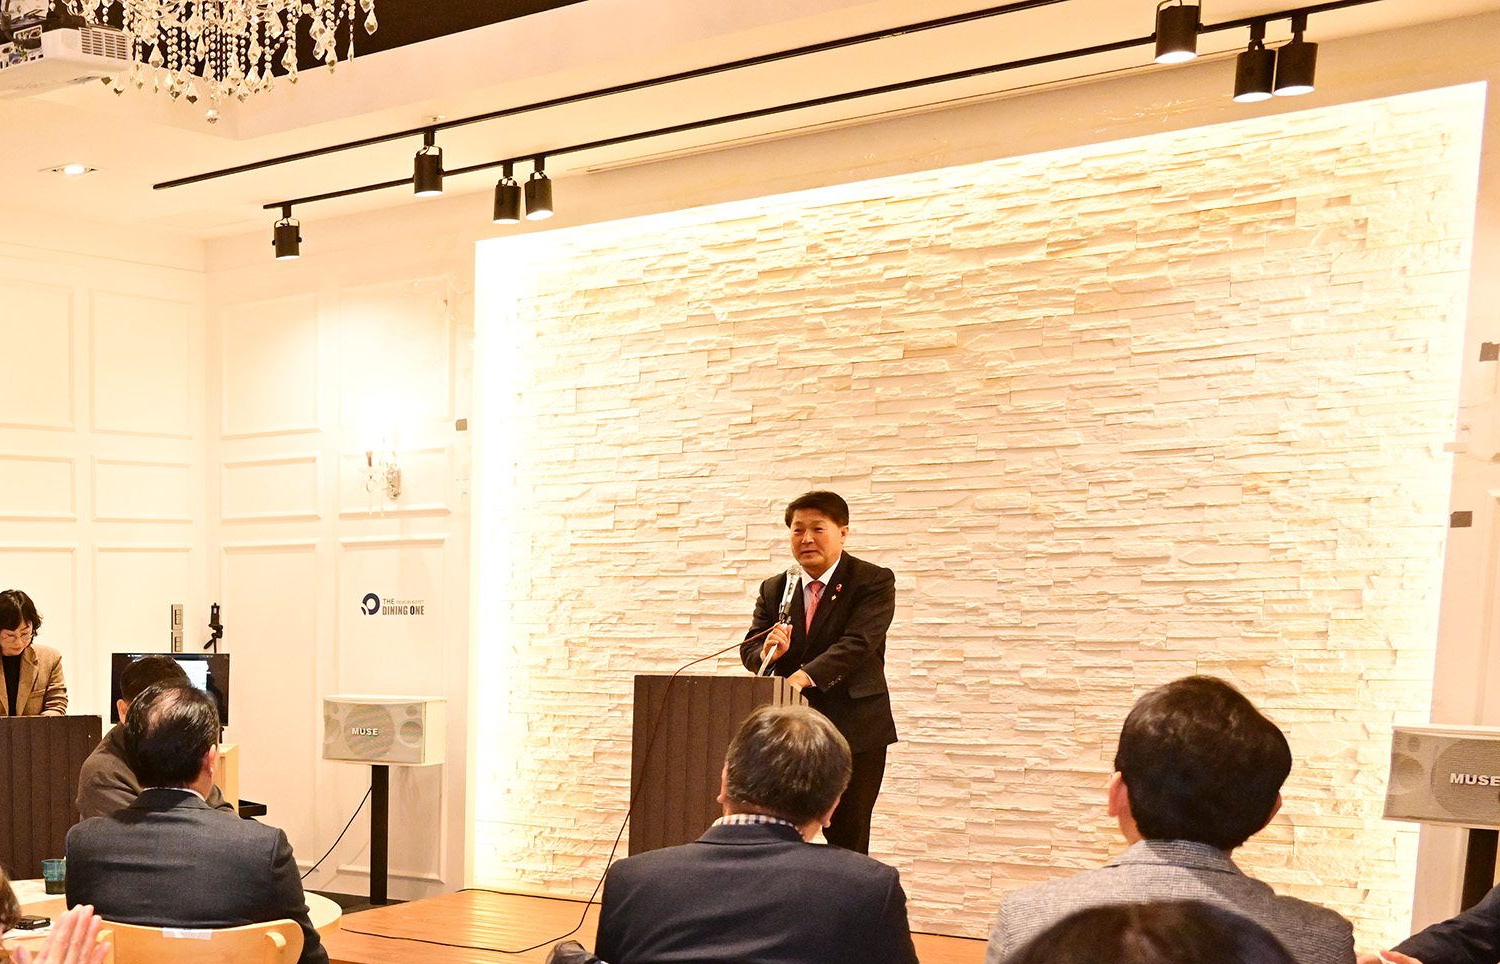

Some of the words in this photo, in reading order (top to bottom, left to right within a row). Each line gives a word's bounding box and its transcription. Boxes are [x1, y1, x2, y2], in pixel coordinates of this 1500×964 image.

[382, 605, 408, 616] DINING
[409, 605, 425, 616] ONE
[351, 727, 379, 736] MUSE
[1449, 772, 1500, 787] MUSE
